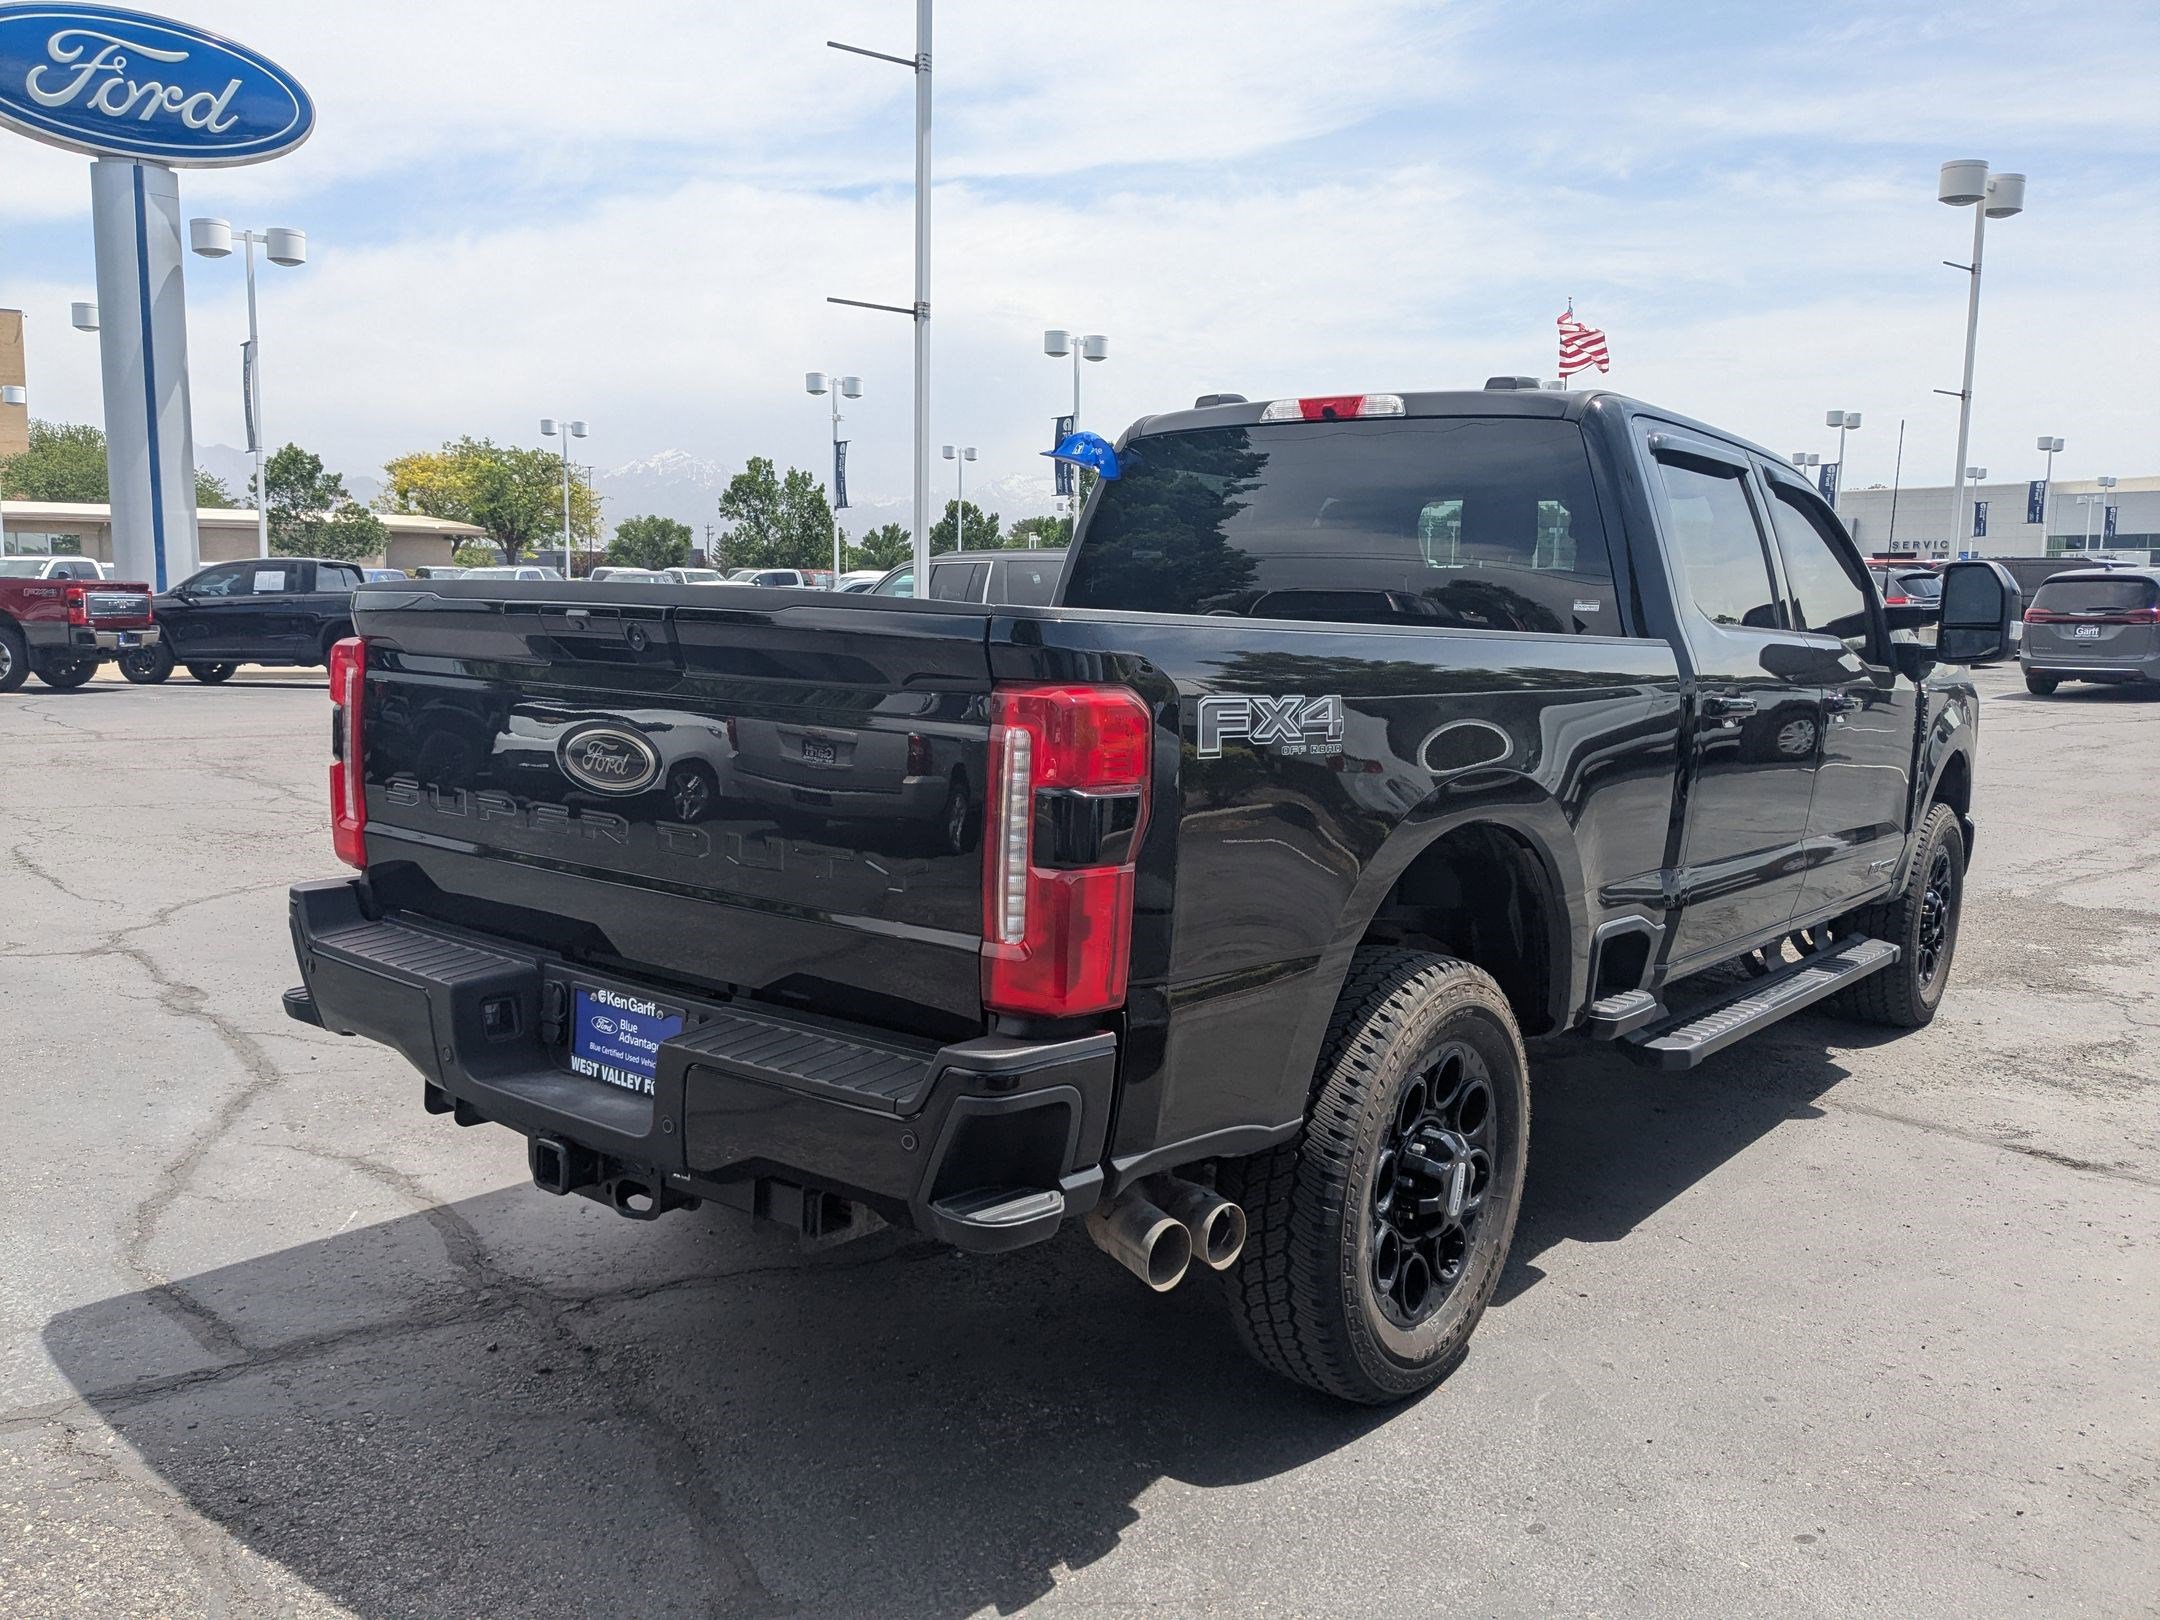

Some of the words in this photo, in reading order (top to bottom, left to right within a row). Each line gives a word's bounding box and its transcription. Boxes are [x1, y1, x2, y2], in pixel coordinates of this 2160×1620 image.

[26, 29, 242, 133] Ford
[1892, 540, 1949, 550] SERVIC
[1197, 695, 1344, 760] FX4
[582, 740, 631, 775] Ford
[1281, 745, 1307, 756] OFF
[1310, 743, 1343, 755] ROAD
[384, 776, 630, 845] SUPER
[655, 820, 929, 893] DUTY
[628, 998, 656, 1016] Garff
[620, 1019, 638, 1033] Blue
[590, 1042, 601, 1051] Blue
[602, 1045, 625, 1060] Certified
[625, 1052, 640, 1064] Used
[571, 1055, 599, 1078] WEST
[601, 1065, 642, 1091] VALLEY
